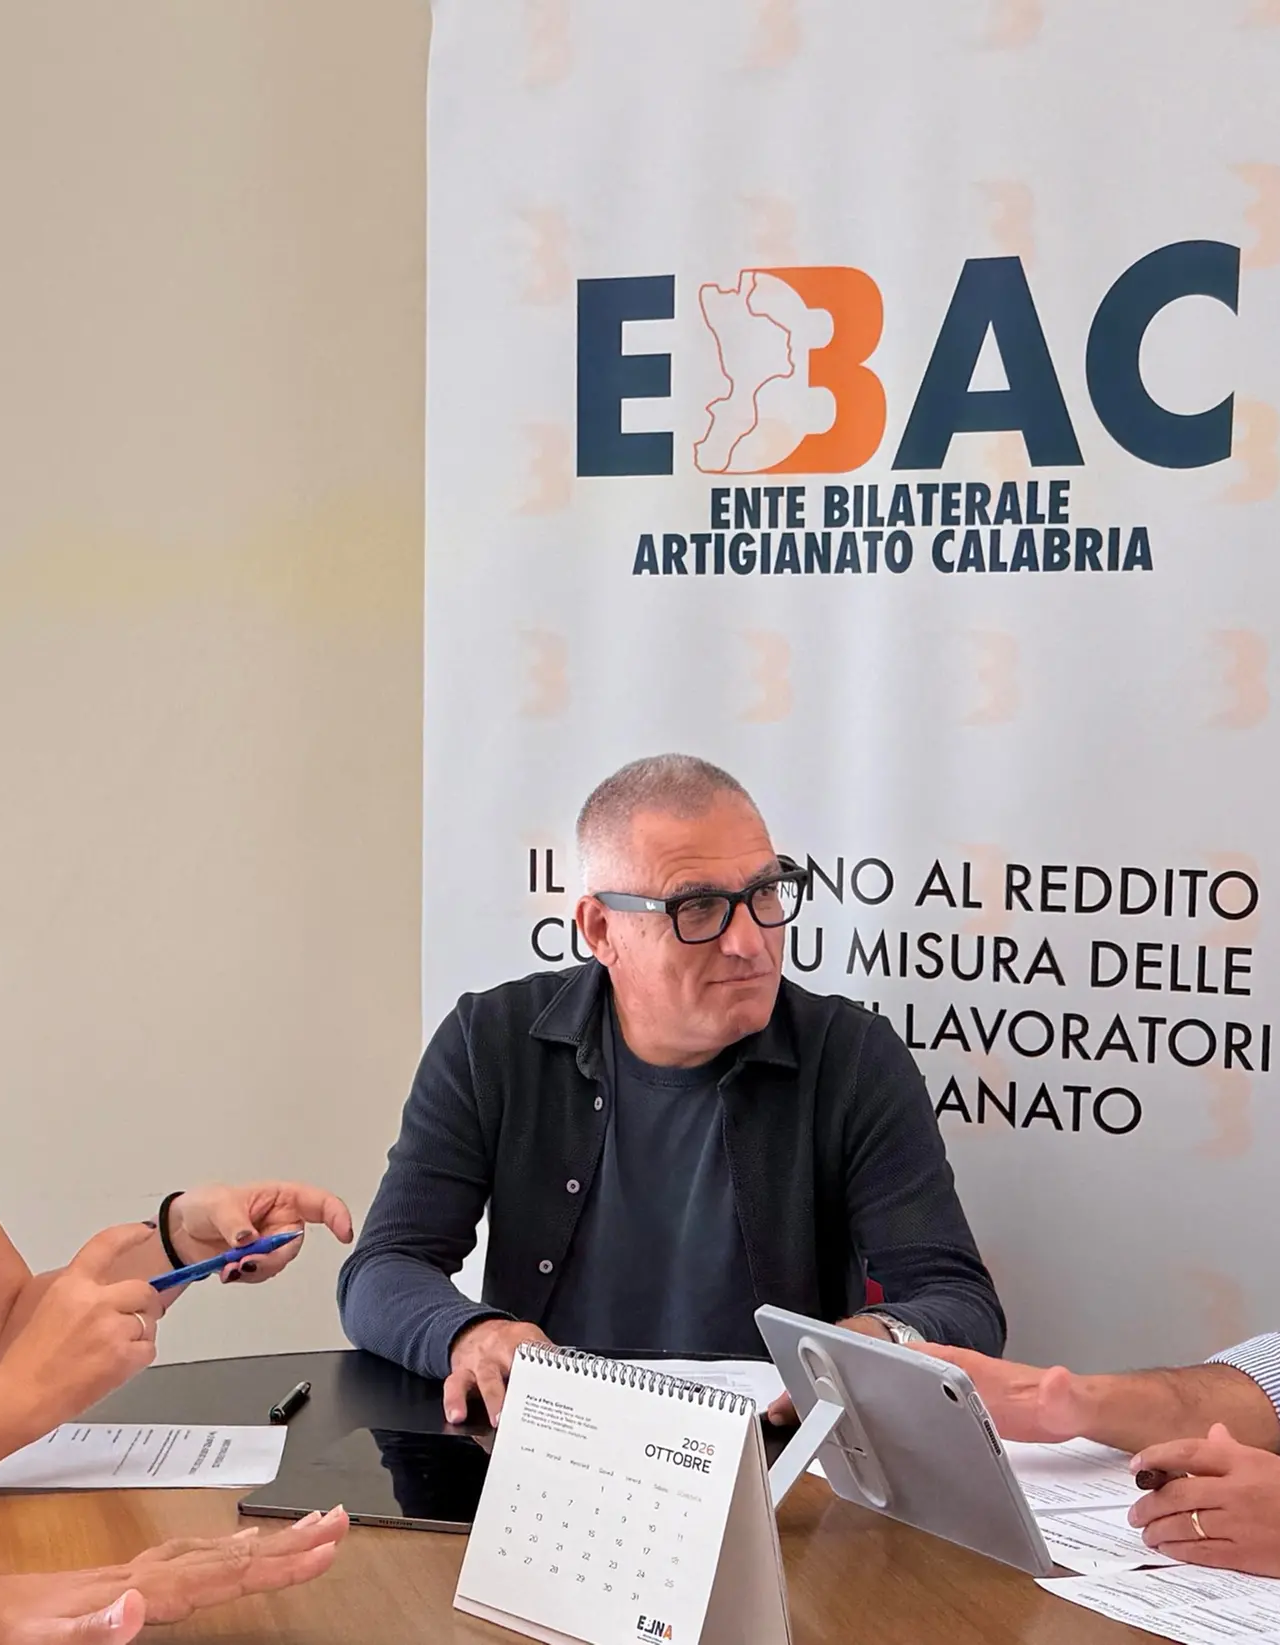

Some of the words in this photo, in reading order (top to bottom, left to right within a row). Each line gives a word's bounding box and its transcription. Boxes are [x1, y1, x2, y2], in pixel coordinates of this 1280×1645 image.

[710, 487, 806, 530] ENTE
[823, 479, 1071, 528] BILATERALE
[632, 530, 914, 576] ARTIGIANATO
[931, 526, 1154, 574] CALABRIA
[529, 848, 565, 893] IL
[914, 859, 983, 910] AL
[1005, 864, 1260, 921] REDDITO
[846, 927, 1067, 987] MISURA
[1090, 940, 1253, 996] DELLE
[906, 1003, 1272, 1072] LAVORATORI
[923, 1074, 1142, 1135] ANATO
[645, 1444, 712, 1474] OTTOBRE
[682, 1437, 715, 1456] 2026
